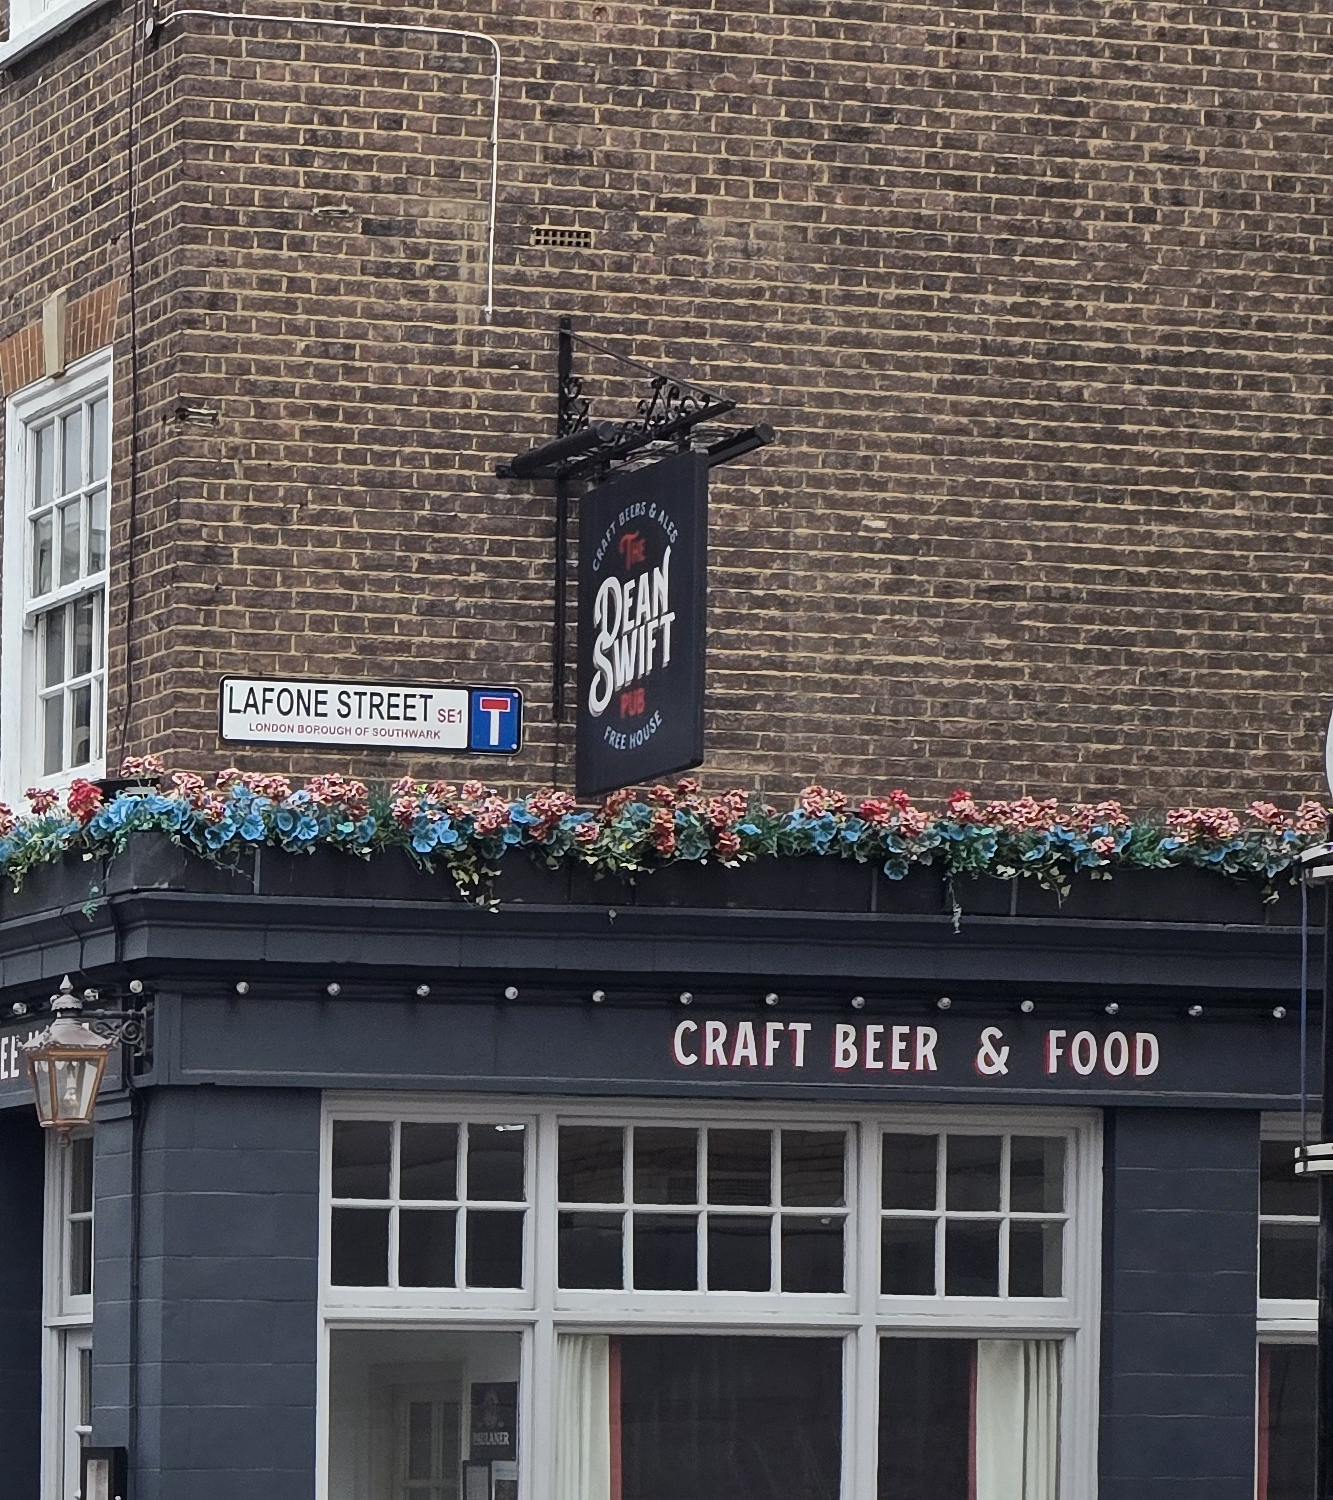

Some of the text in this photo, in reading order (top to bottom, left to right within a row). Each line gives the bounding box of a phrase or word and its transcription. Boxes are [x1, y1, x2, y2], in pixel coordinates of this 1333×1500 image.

[593, 501, 678, 571] CRAFT BEERS & ALES
[593, 545, 671, 651] DEAN
[589, 612, 675, 717] SWIFT
[228, 686, 463, 724] LAFONE STREET SE1
[620, 687, 646, 719] PUB
[249, 722, 441, 740] LONDON BOROUGH OF SOUTHWARK
[604, 710, 662, 749] FREE HOUSE
[672, 1020, 1160, 1077] CRAFT BEER & FOOD
